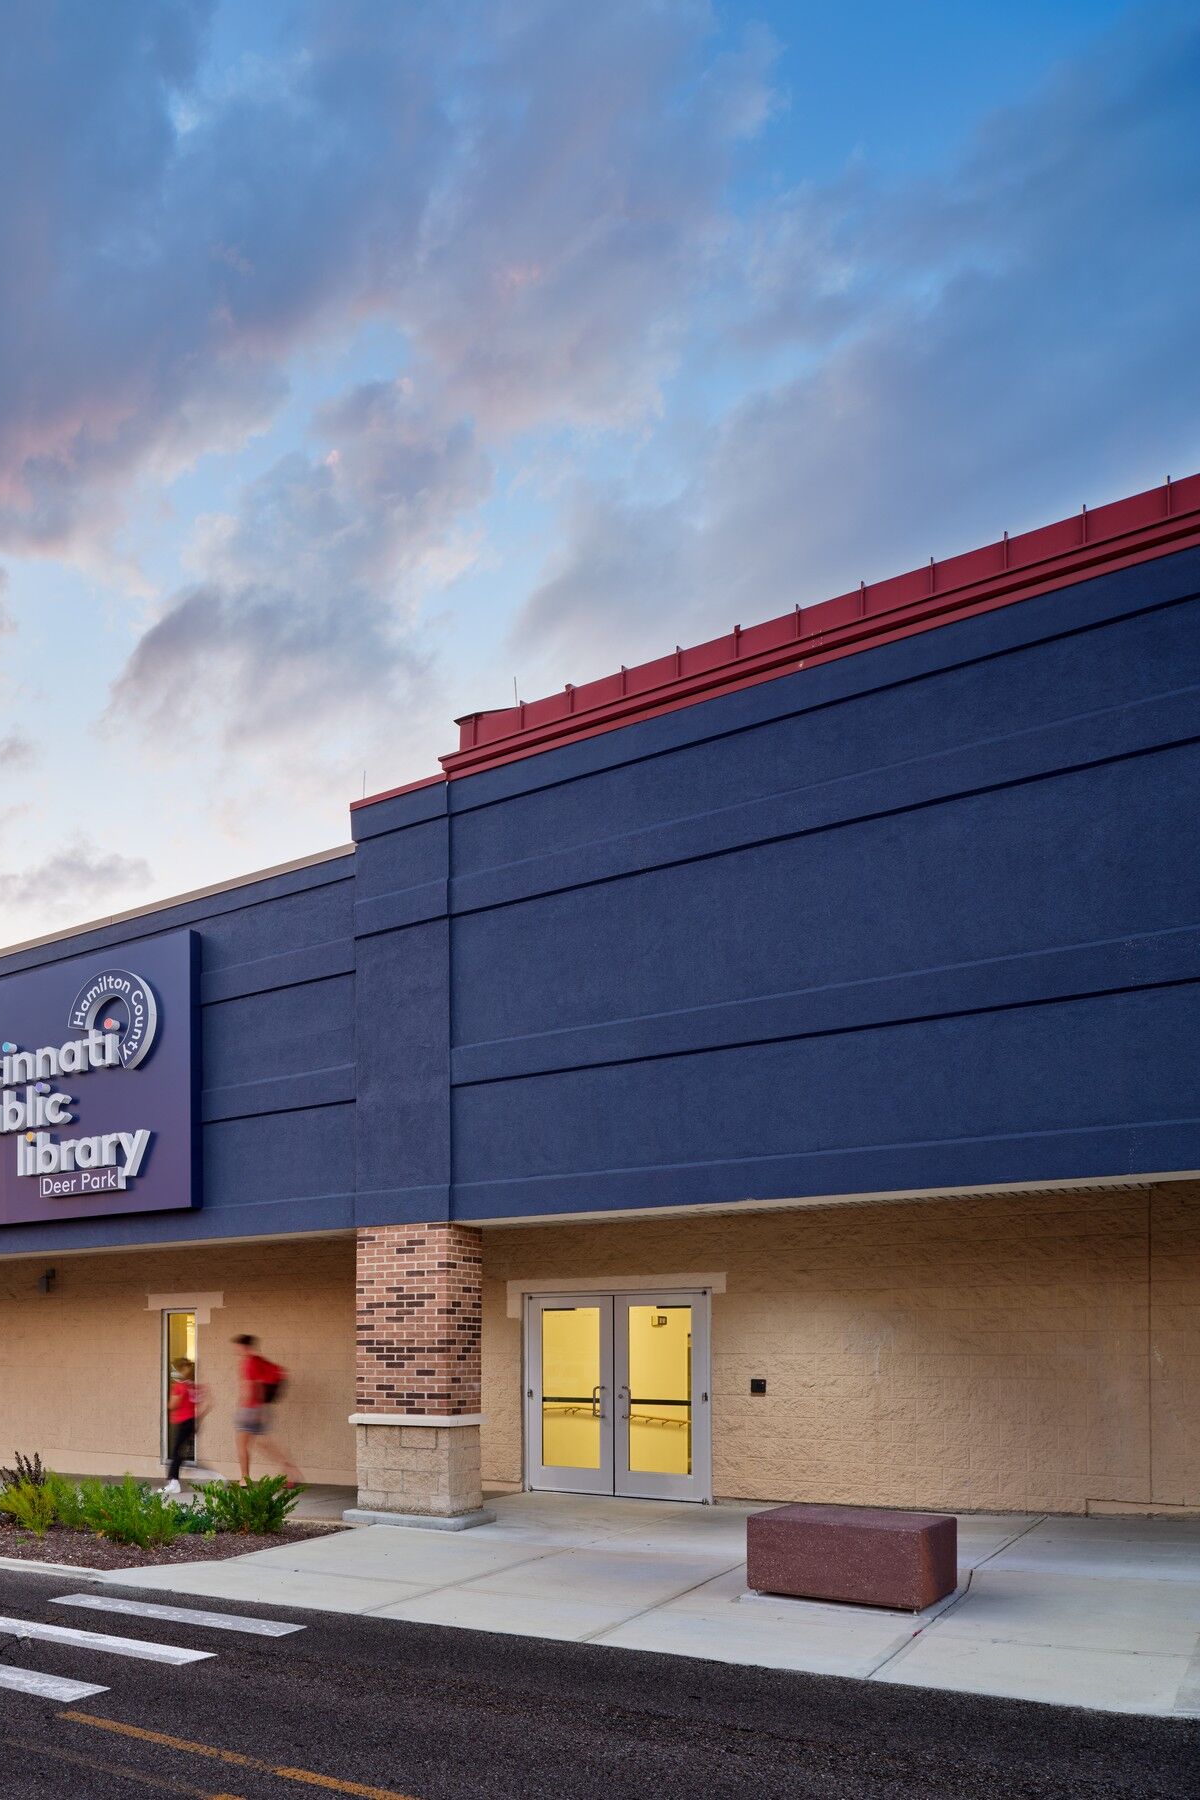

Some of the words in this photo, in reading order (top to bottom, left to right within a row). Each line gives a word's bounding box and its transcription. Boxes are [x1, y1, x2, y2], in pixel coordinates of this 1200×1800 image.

[73, 974, 131, 1026] Hamilton
[121, 990, 145, 1061] County
[17, 1129, 150, 1190] library
[42, 1176, 77, 1195] Deer
[81, 1170, 117, 1191] Park
